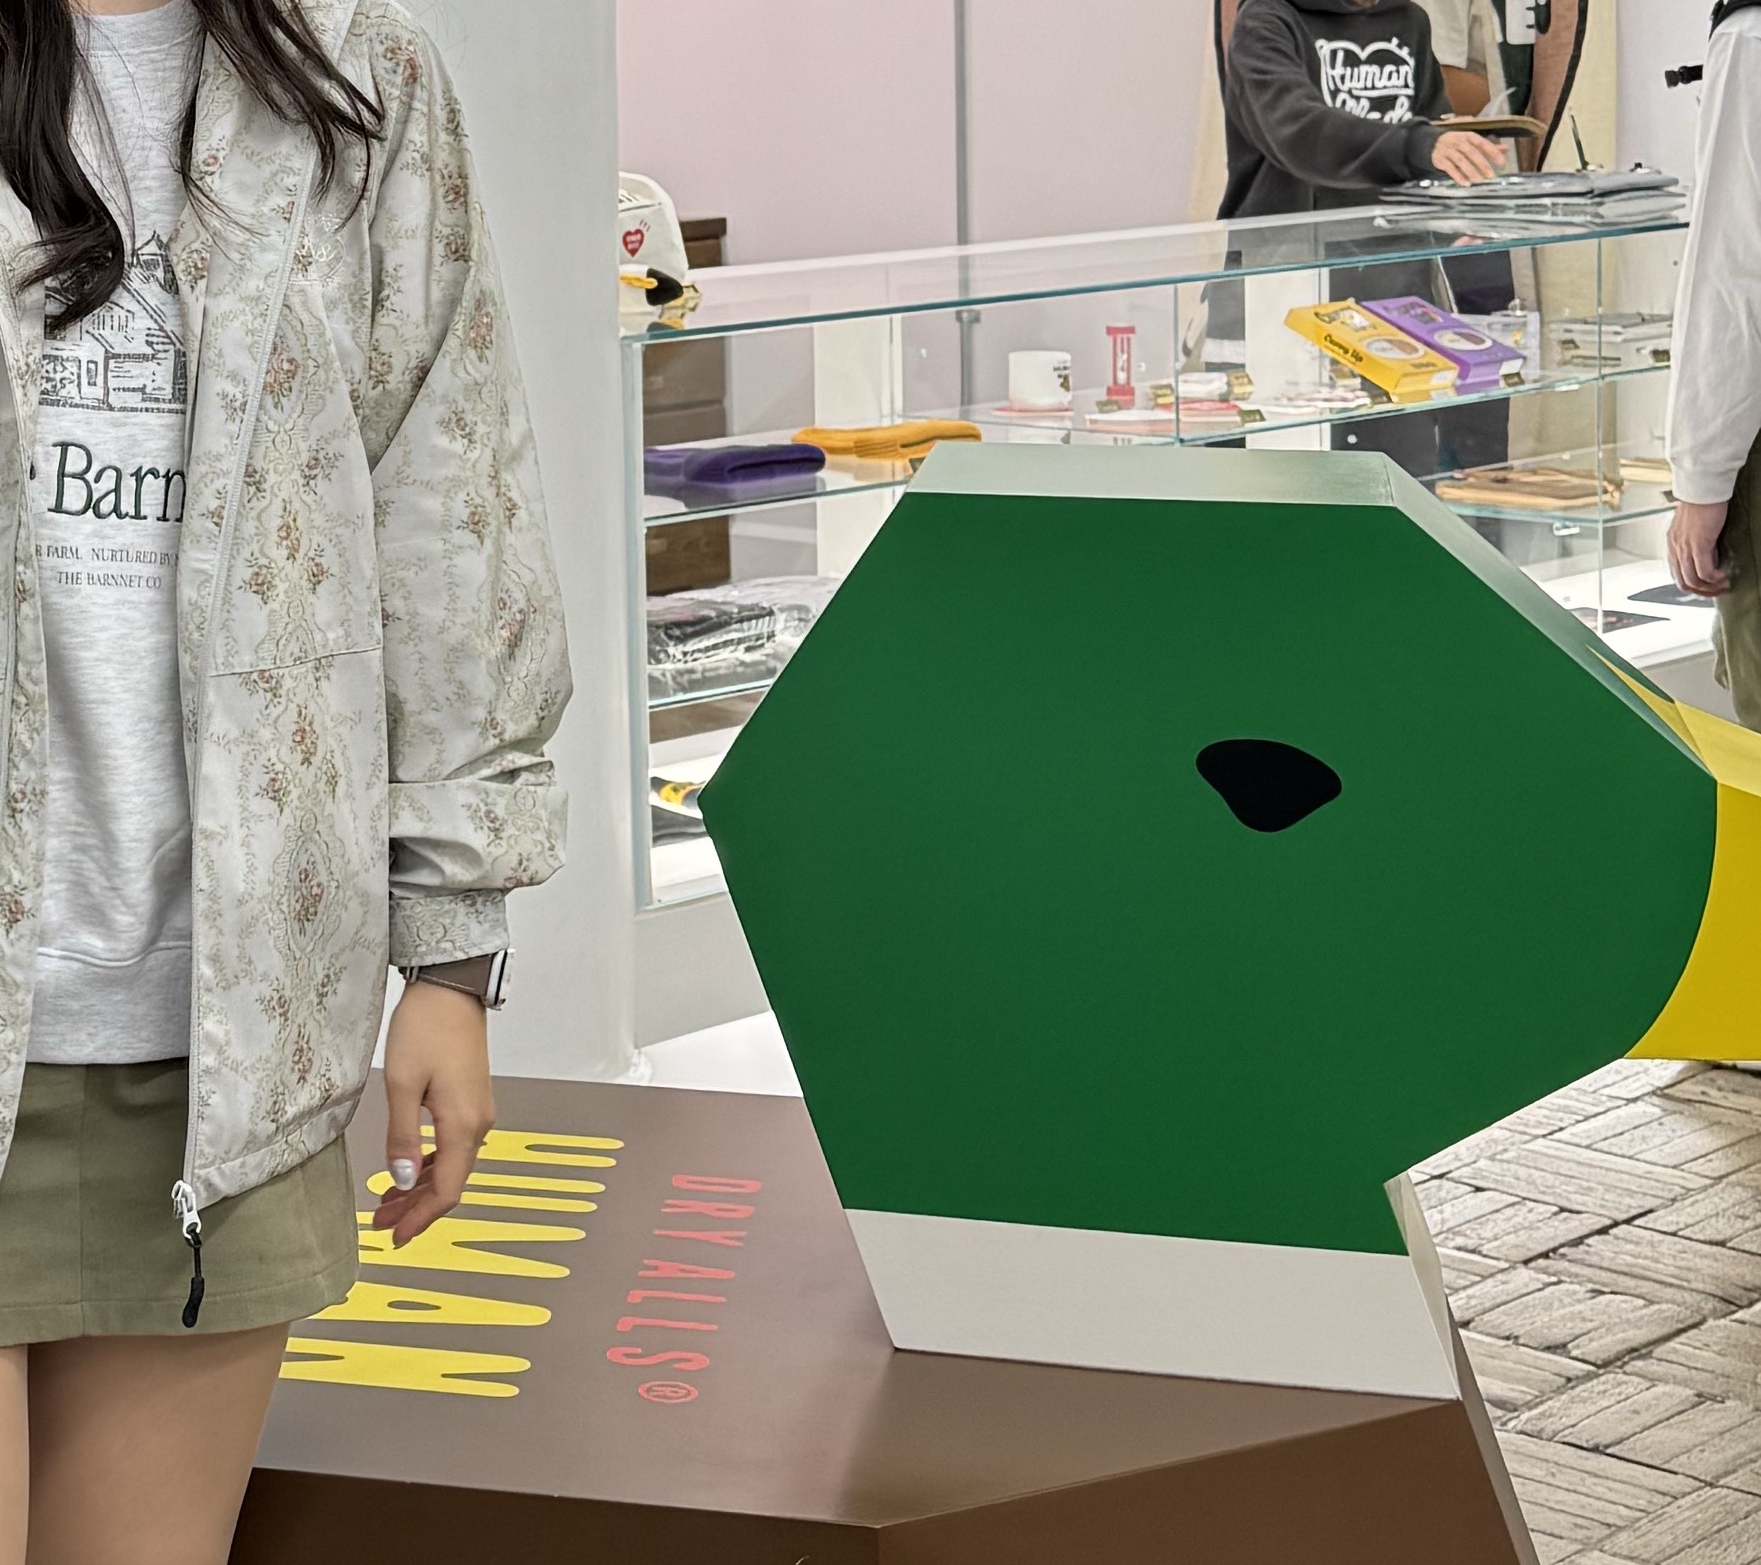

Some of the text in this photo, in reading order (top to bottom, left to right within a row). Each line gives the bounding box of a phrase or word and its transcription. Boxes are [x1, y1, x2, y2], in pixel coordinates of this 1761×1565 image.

[1324, 47, 1415, 91] Human
[91, 547, 157, 564] NURTURED
[57, 571, 83, 585] THE
